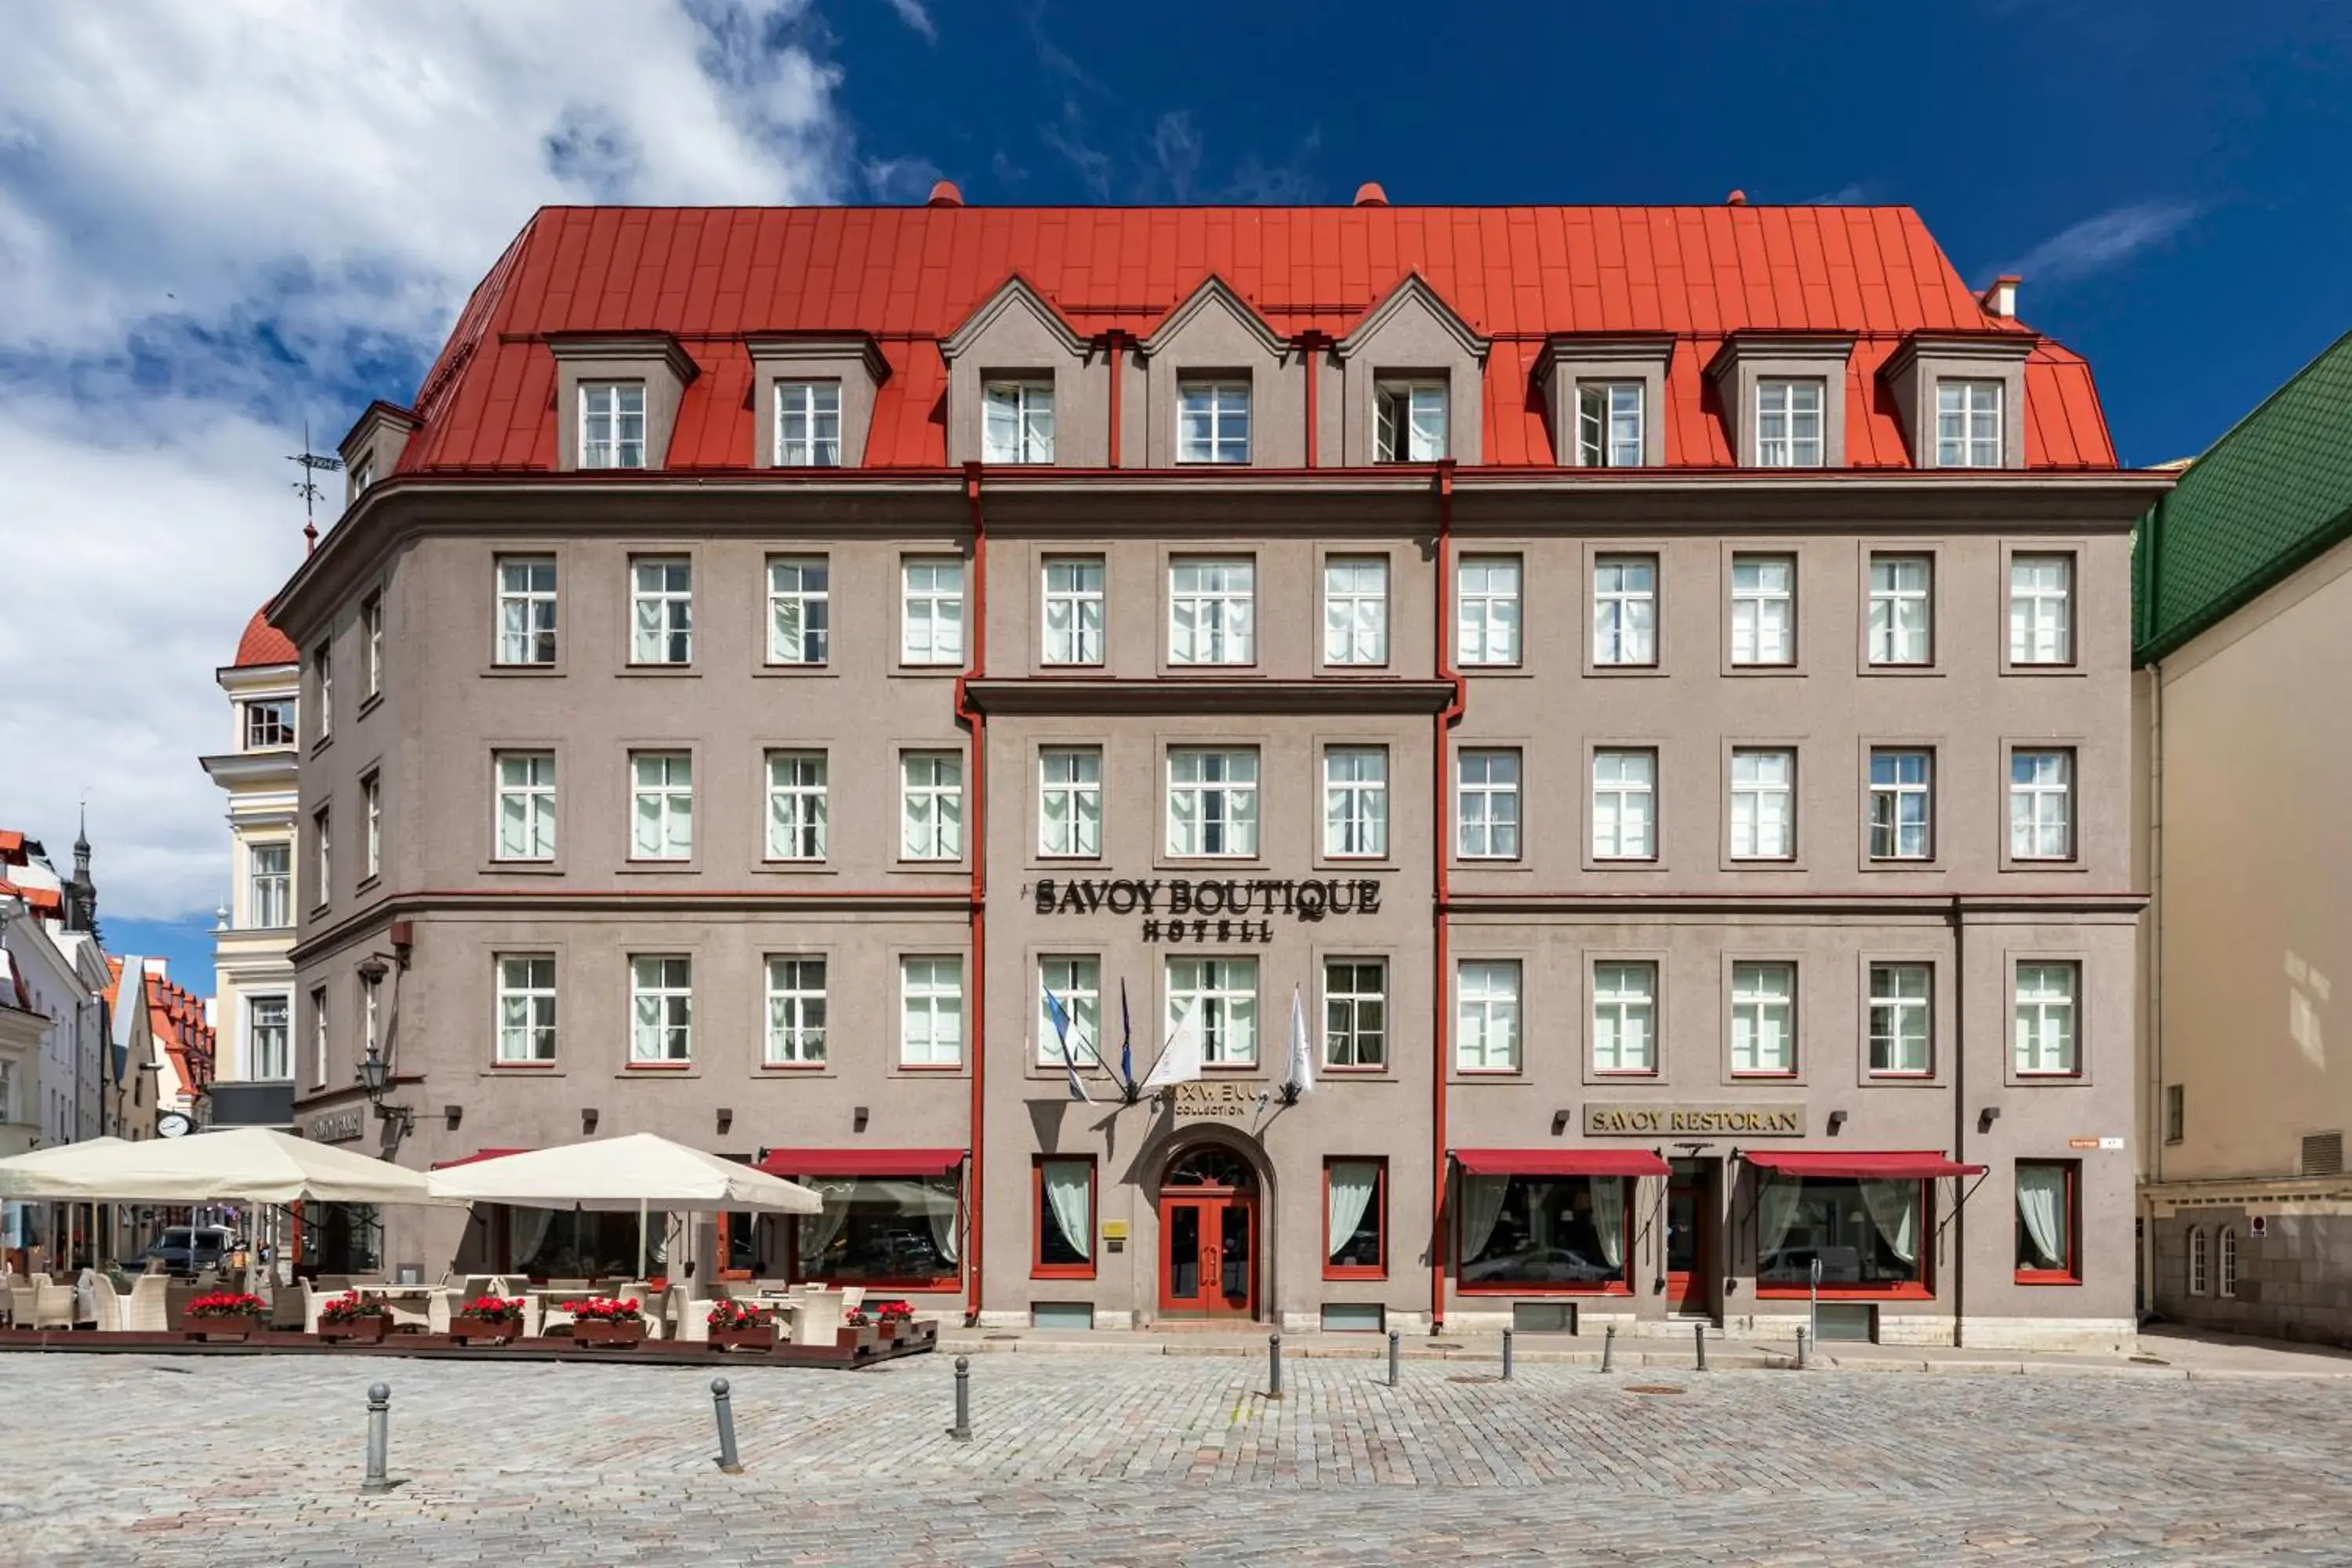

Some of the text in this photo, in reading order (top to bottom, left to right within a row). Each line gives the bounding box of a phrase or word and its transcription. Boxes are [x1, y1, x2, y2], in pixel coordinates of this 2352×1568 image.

[1035, 880, 1381, 922] SAVOY BOUTIQUE
[1142, 920, 1273, 942] HOTELL
[1176, 1105, 1245, 1116] COLLECTION
[1592, 1112, 1797, 1131] SAVOY RESTORAN
